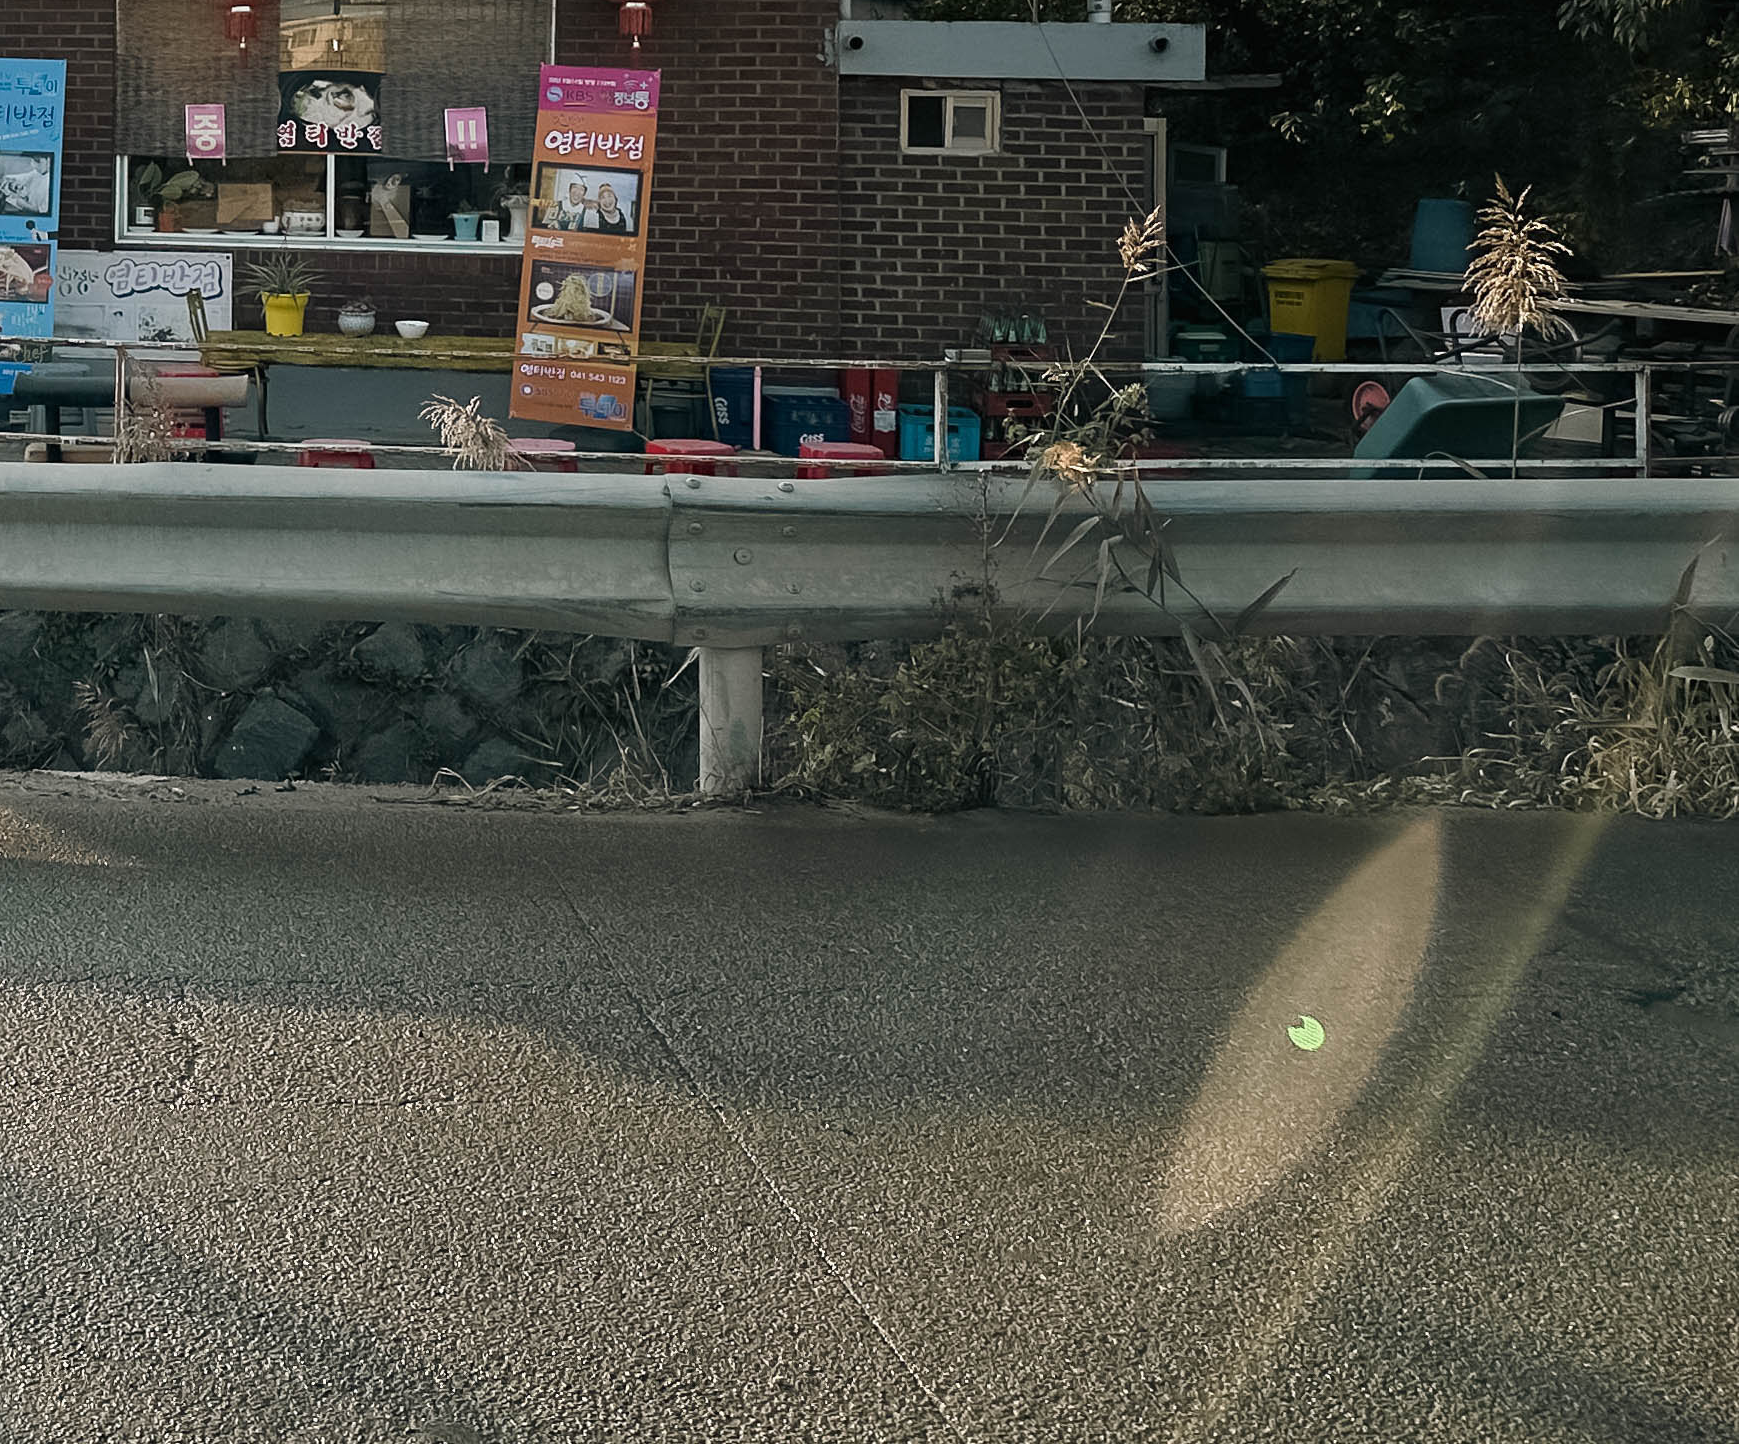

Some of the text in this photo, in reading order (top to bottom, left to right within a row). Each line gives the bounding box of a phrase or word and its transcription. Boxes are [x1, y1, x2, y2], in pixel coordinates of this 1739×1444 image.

[566, 89, 595, 102] KBS
[188, 114, 221, 152] 중
[544, 129, 644, 161] 염티반점
[109, 261, 216, 294] 염티반점
[570, 370, 586, 379] 041
